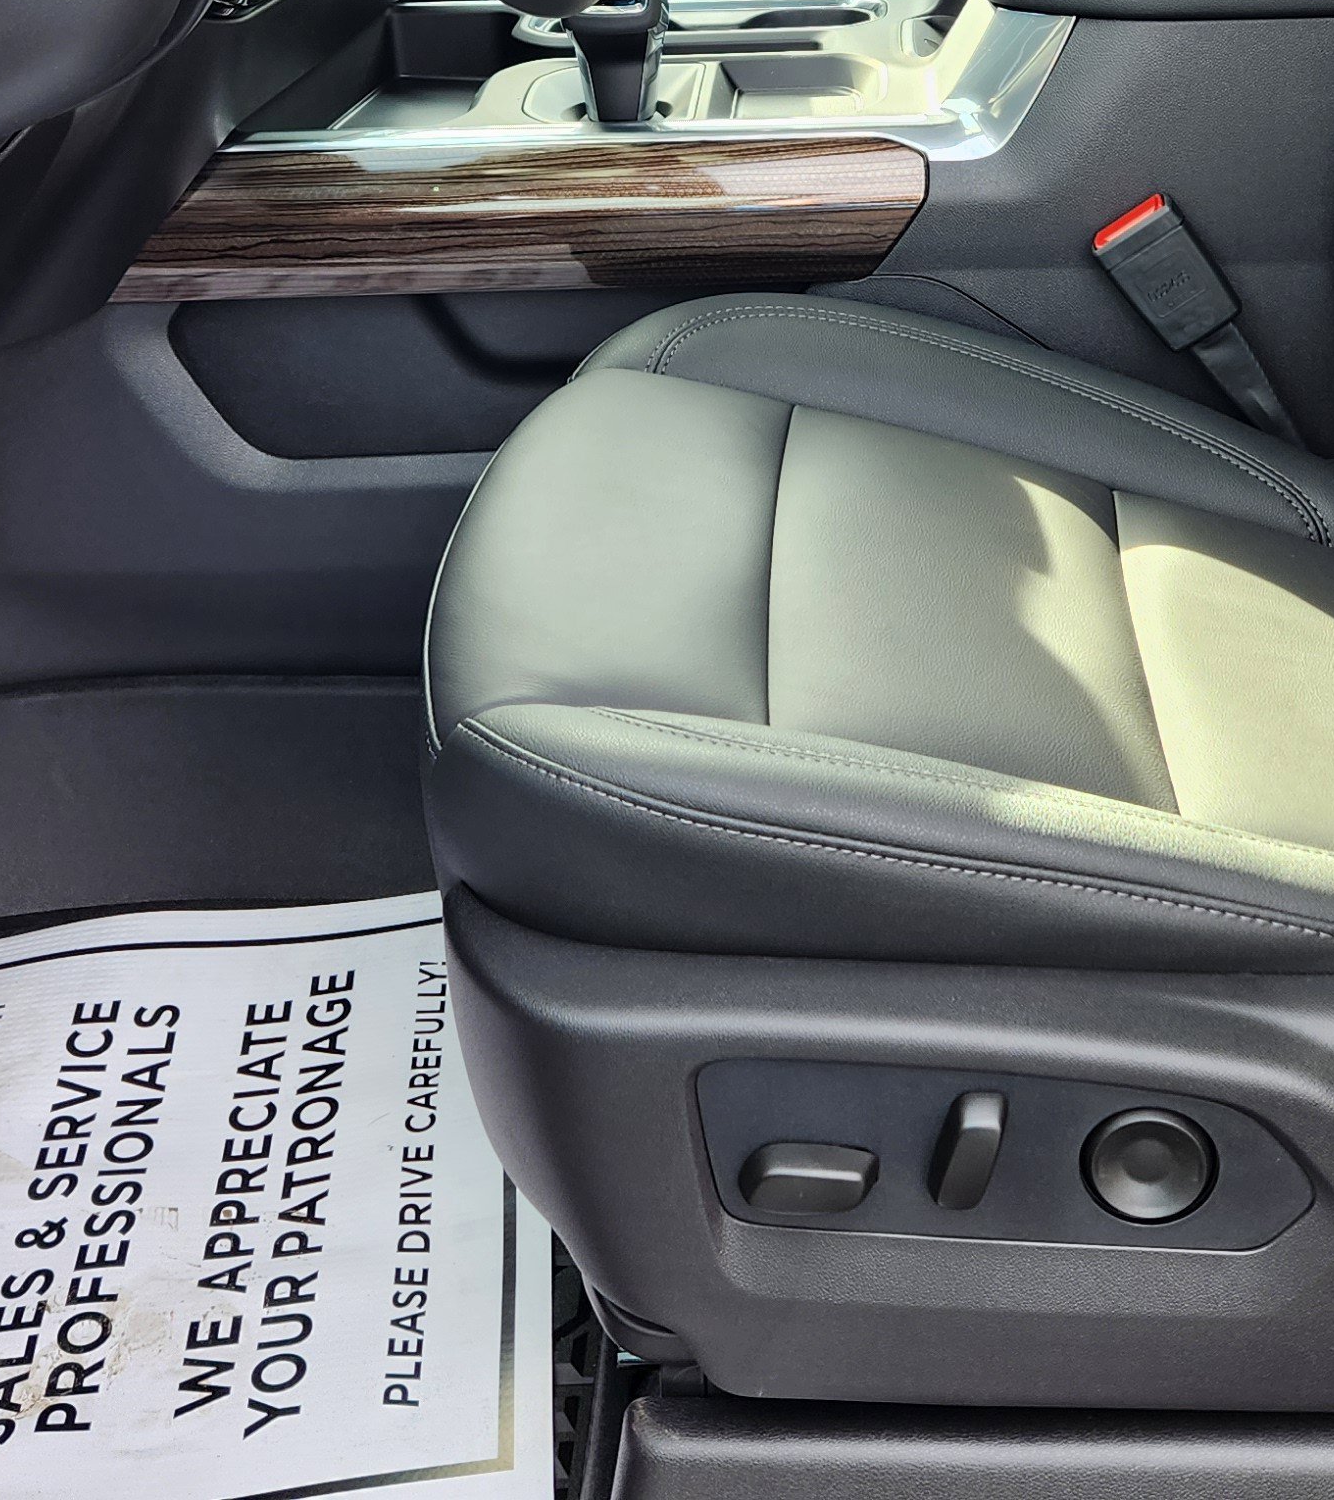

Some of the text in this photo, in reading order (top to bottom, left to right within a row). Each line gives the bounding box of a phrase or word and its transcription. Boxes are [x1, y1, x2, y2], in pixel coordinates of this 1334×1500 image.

[14, 1216, 69, 1250] &
[27, 1000, 122, 1201] SERVICE
[33, 1004, 181, 1433] PROFESSIONALS
[173, 1000, 293, 1419] WE APPRECIATE
[243, 969, 355, 1439] YOUR PATRONAGE
[383, 961, 448, 1407] PLEASE DRIVE CAREFULLY!
